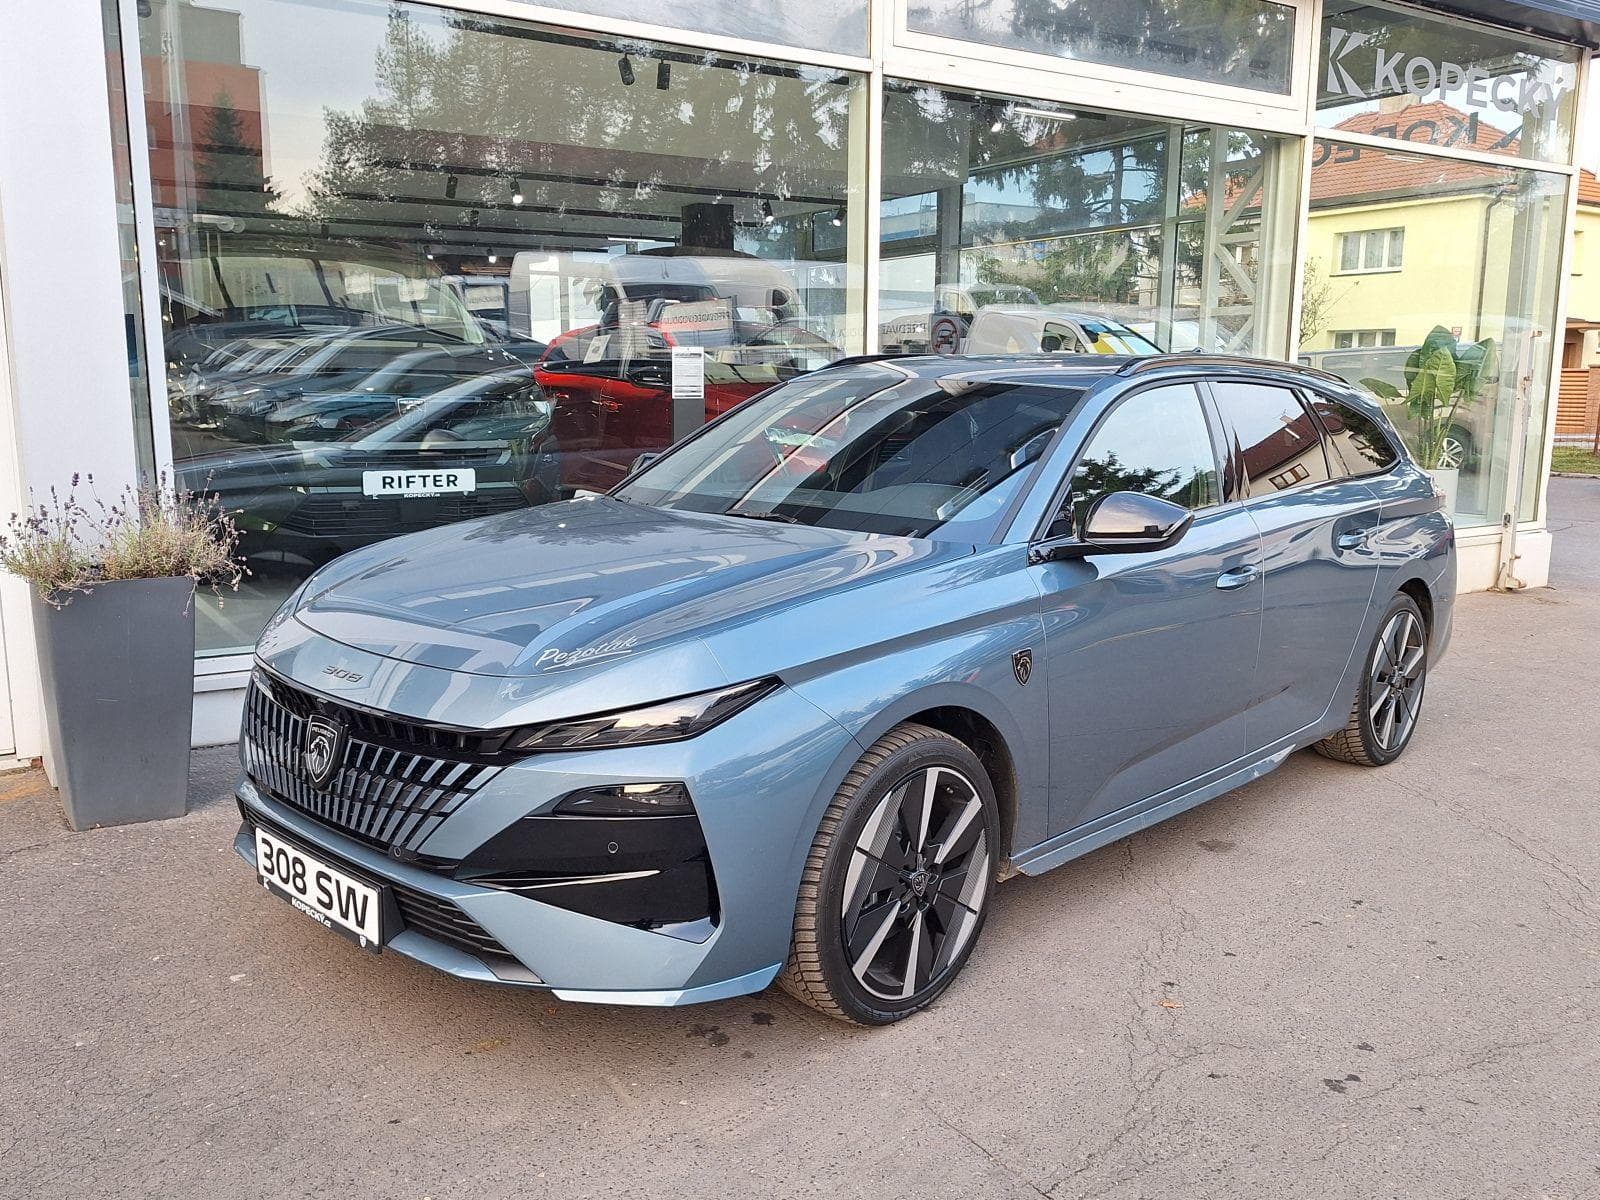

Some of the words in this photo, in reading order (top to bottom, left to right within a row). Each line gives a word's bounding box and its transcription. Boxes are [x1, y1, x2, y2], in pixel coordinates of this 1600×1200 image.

[1375, 48, 1567, 121] KOPECKÝ
[381, 473, 459, 490] RIFTER
[321, 665, 364, 683] 308
[261, 836, 308, 896] 308
[315, 869, 369, 930] SW
